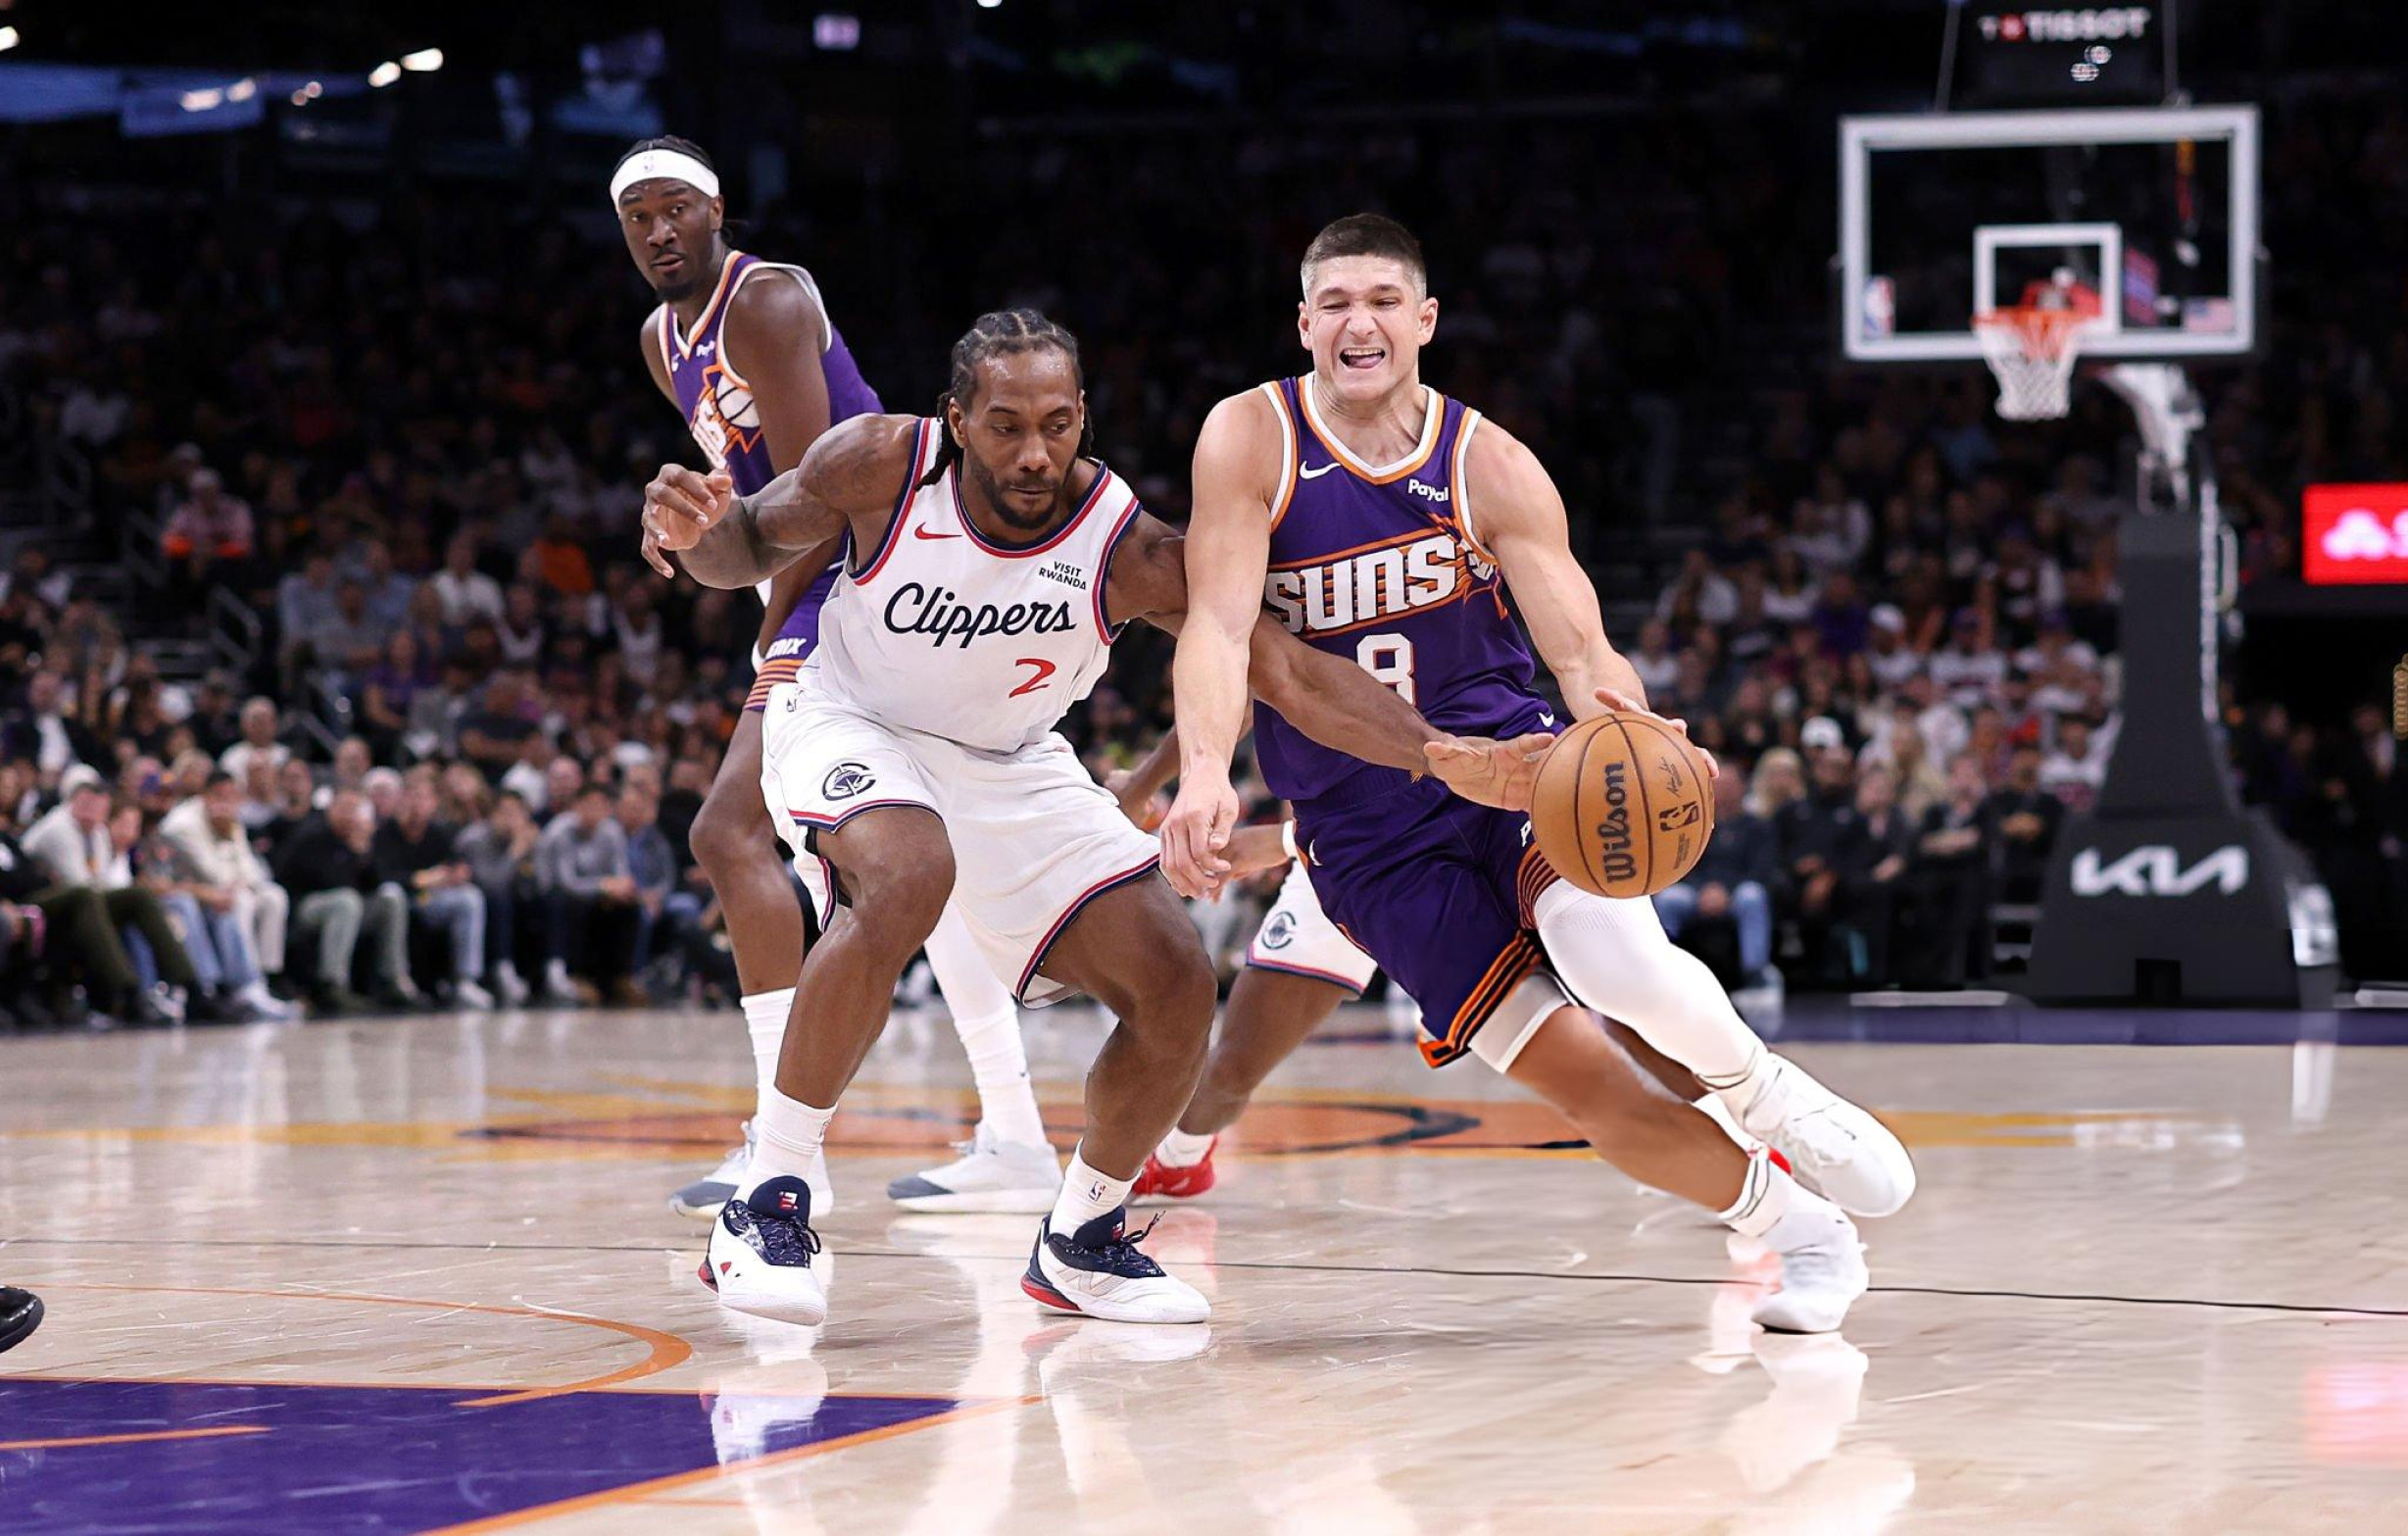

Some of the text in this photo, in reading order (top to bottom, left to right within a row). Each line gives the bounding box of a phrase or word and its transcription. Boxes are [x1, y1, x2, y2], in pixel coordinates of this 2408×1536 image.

[1039, 568, 1086, 590] RWANDA
[1054, 561, 1082, 576] VISIT
[1264, 535, 1455, 633] SUNS
[884, 582, 1077, 649] Clippers
[1008, 658, 1057, 698] 2
[1597, 760, 1636, 884] Wilson
